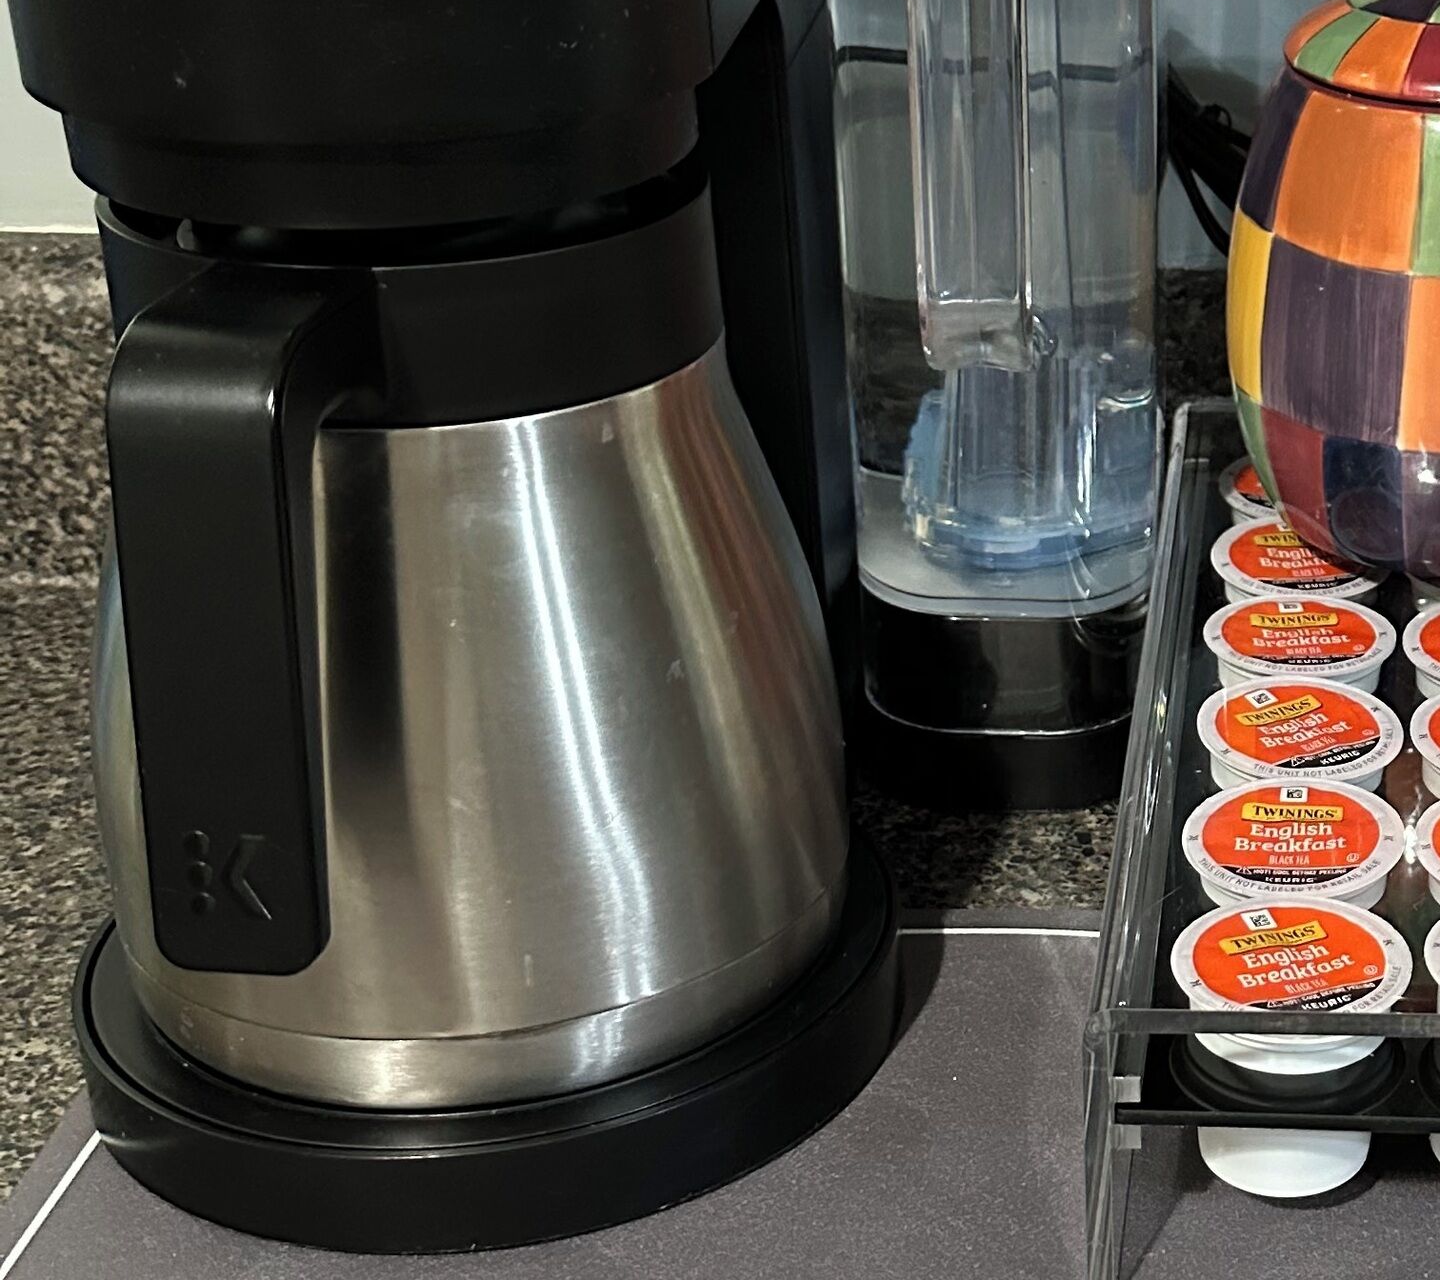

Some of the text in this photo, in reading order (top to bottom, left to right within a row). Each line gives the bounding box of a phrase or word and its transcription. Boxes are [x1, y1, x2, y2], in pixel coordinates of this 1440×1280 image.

[1252, 634, 1350, 648] Breakfast
[1263, 628, 1333, 641] English
[1243, 698, 1314, 723] TWININGS
[1259, 712, 1330, 735] English
[1260, 721, 1352, 748] Breakfast
[1252, 805, 1337, 820] TWININGS
[1251, 822, 1333, 838] English
[1234, 837, 1347, 853] Breakfast
[1230, 924, 1316, 950] TWININGS
[1242, 944, 1330, 970] English
[1236, 953, 1356, 989] Breakfast
[1301, 994, 1352, 1010] KEURIG
